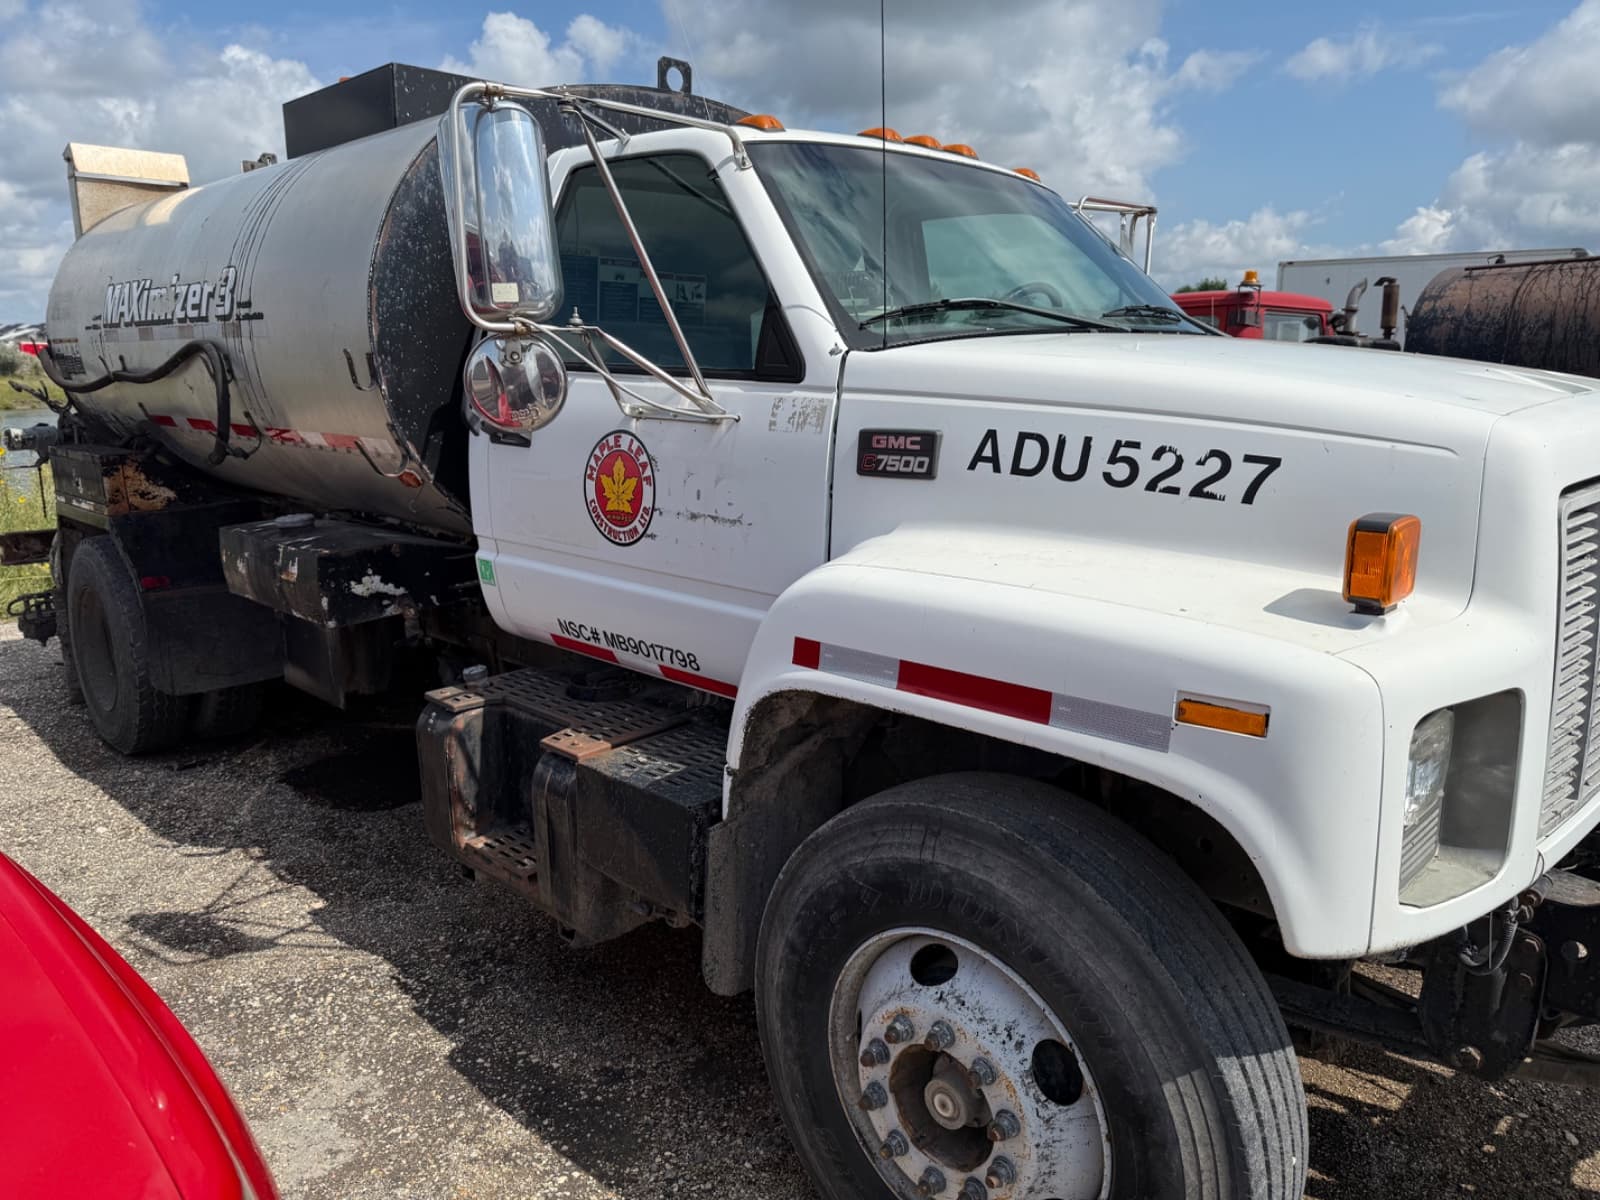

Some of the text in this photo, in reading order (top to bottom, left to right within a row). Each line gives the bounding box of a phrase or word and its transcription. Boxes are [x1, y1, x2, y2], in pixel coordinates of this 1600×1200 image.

[586, 435, 652, 487] MAPLE LEAF
[861, 453, 930, 473] C7500
[872, 434, 921, 450] GMC
[967, 429, 1283, 505] ADU 5227
[589, 499, 640, 542] CONSTRUCTION
[557, 618, 701, 671] NSC# MB9017798
